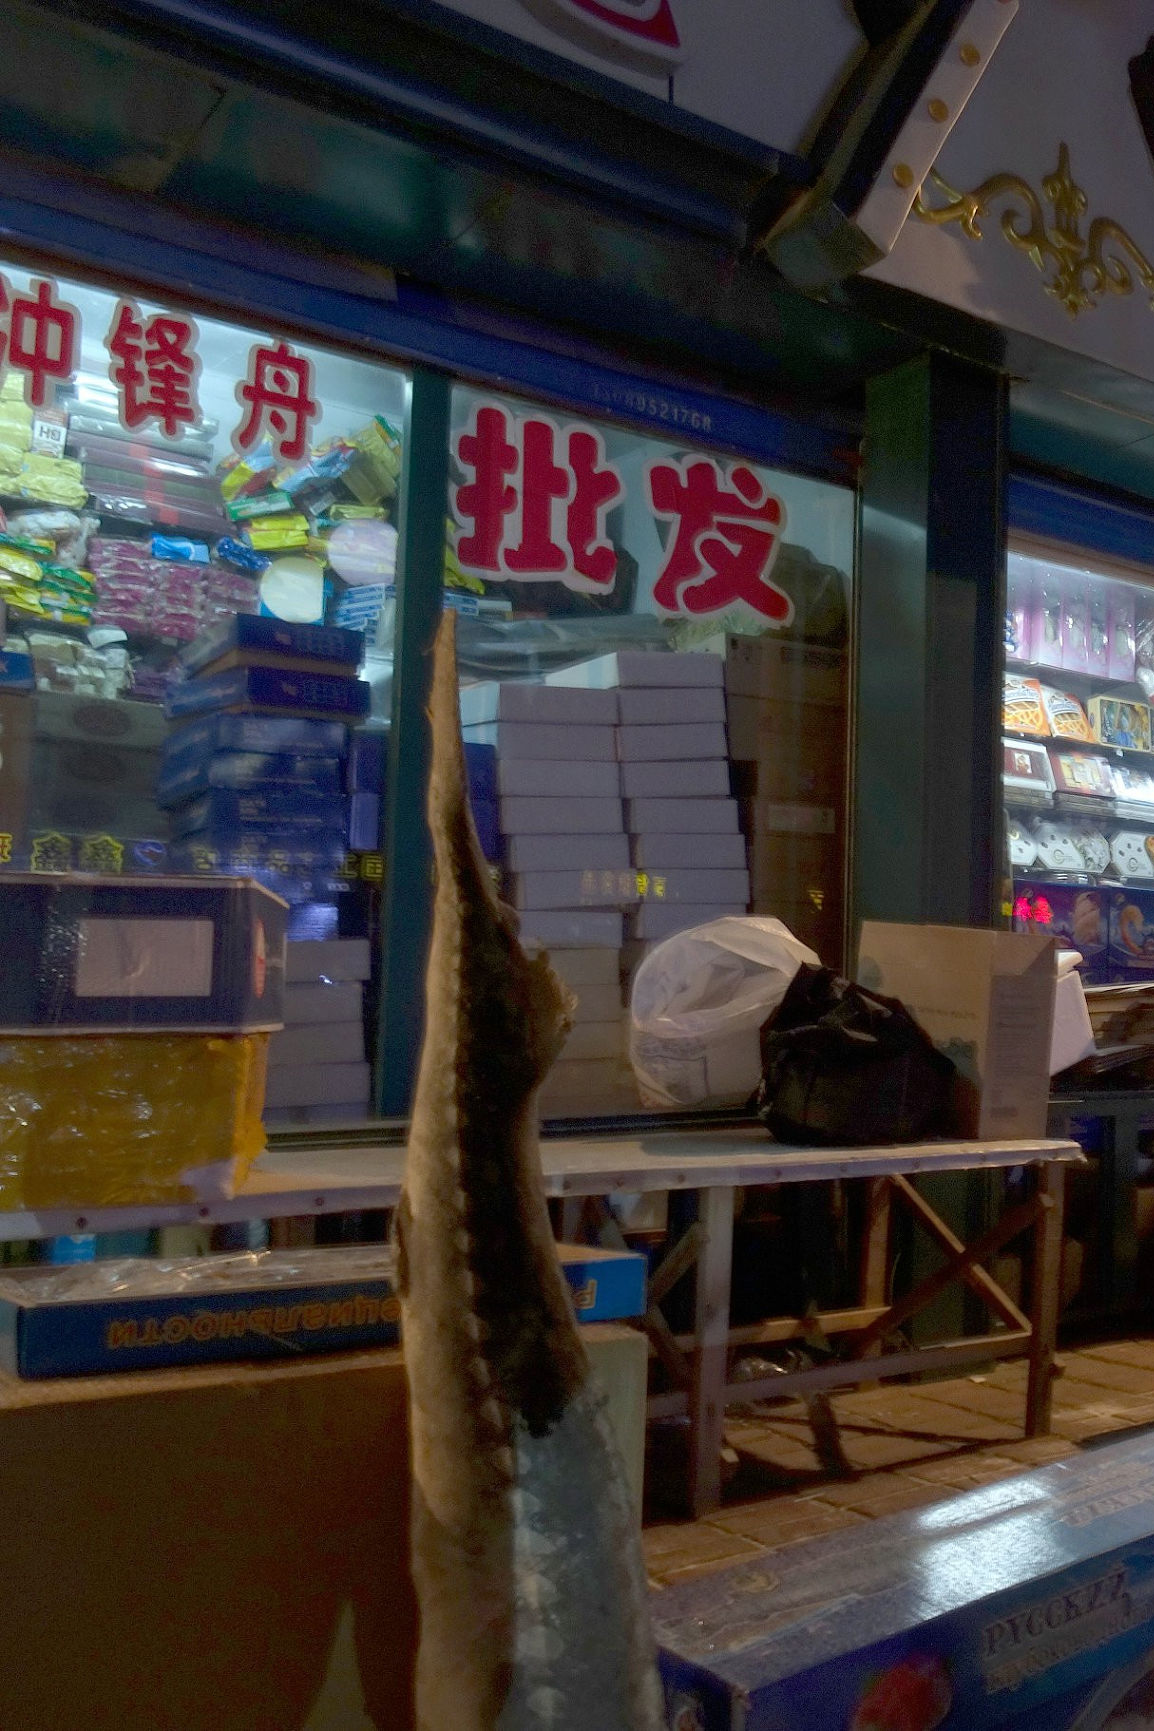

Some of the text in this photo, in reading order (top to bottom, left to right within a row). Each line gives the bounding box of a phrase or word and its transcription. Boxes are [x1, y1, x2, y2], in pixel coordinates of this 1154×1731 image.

[0, 280, 319, 462] 冲锋舟
[455, 406, 792, 622] 批发
